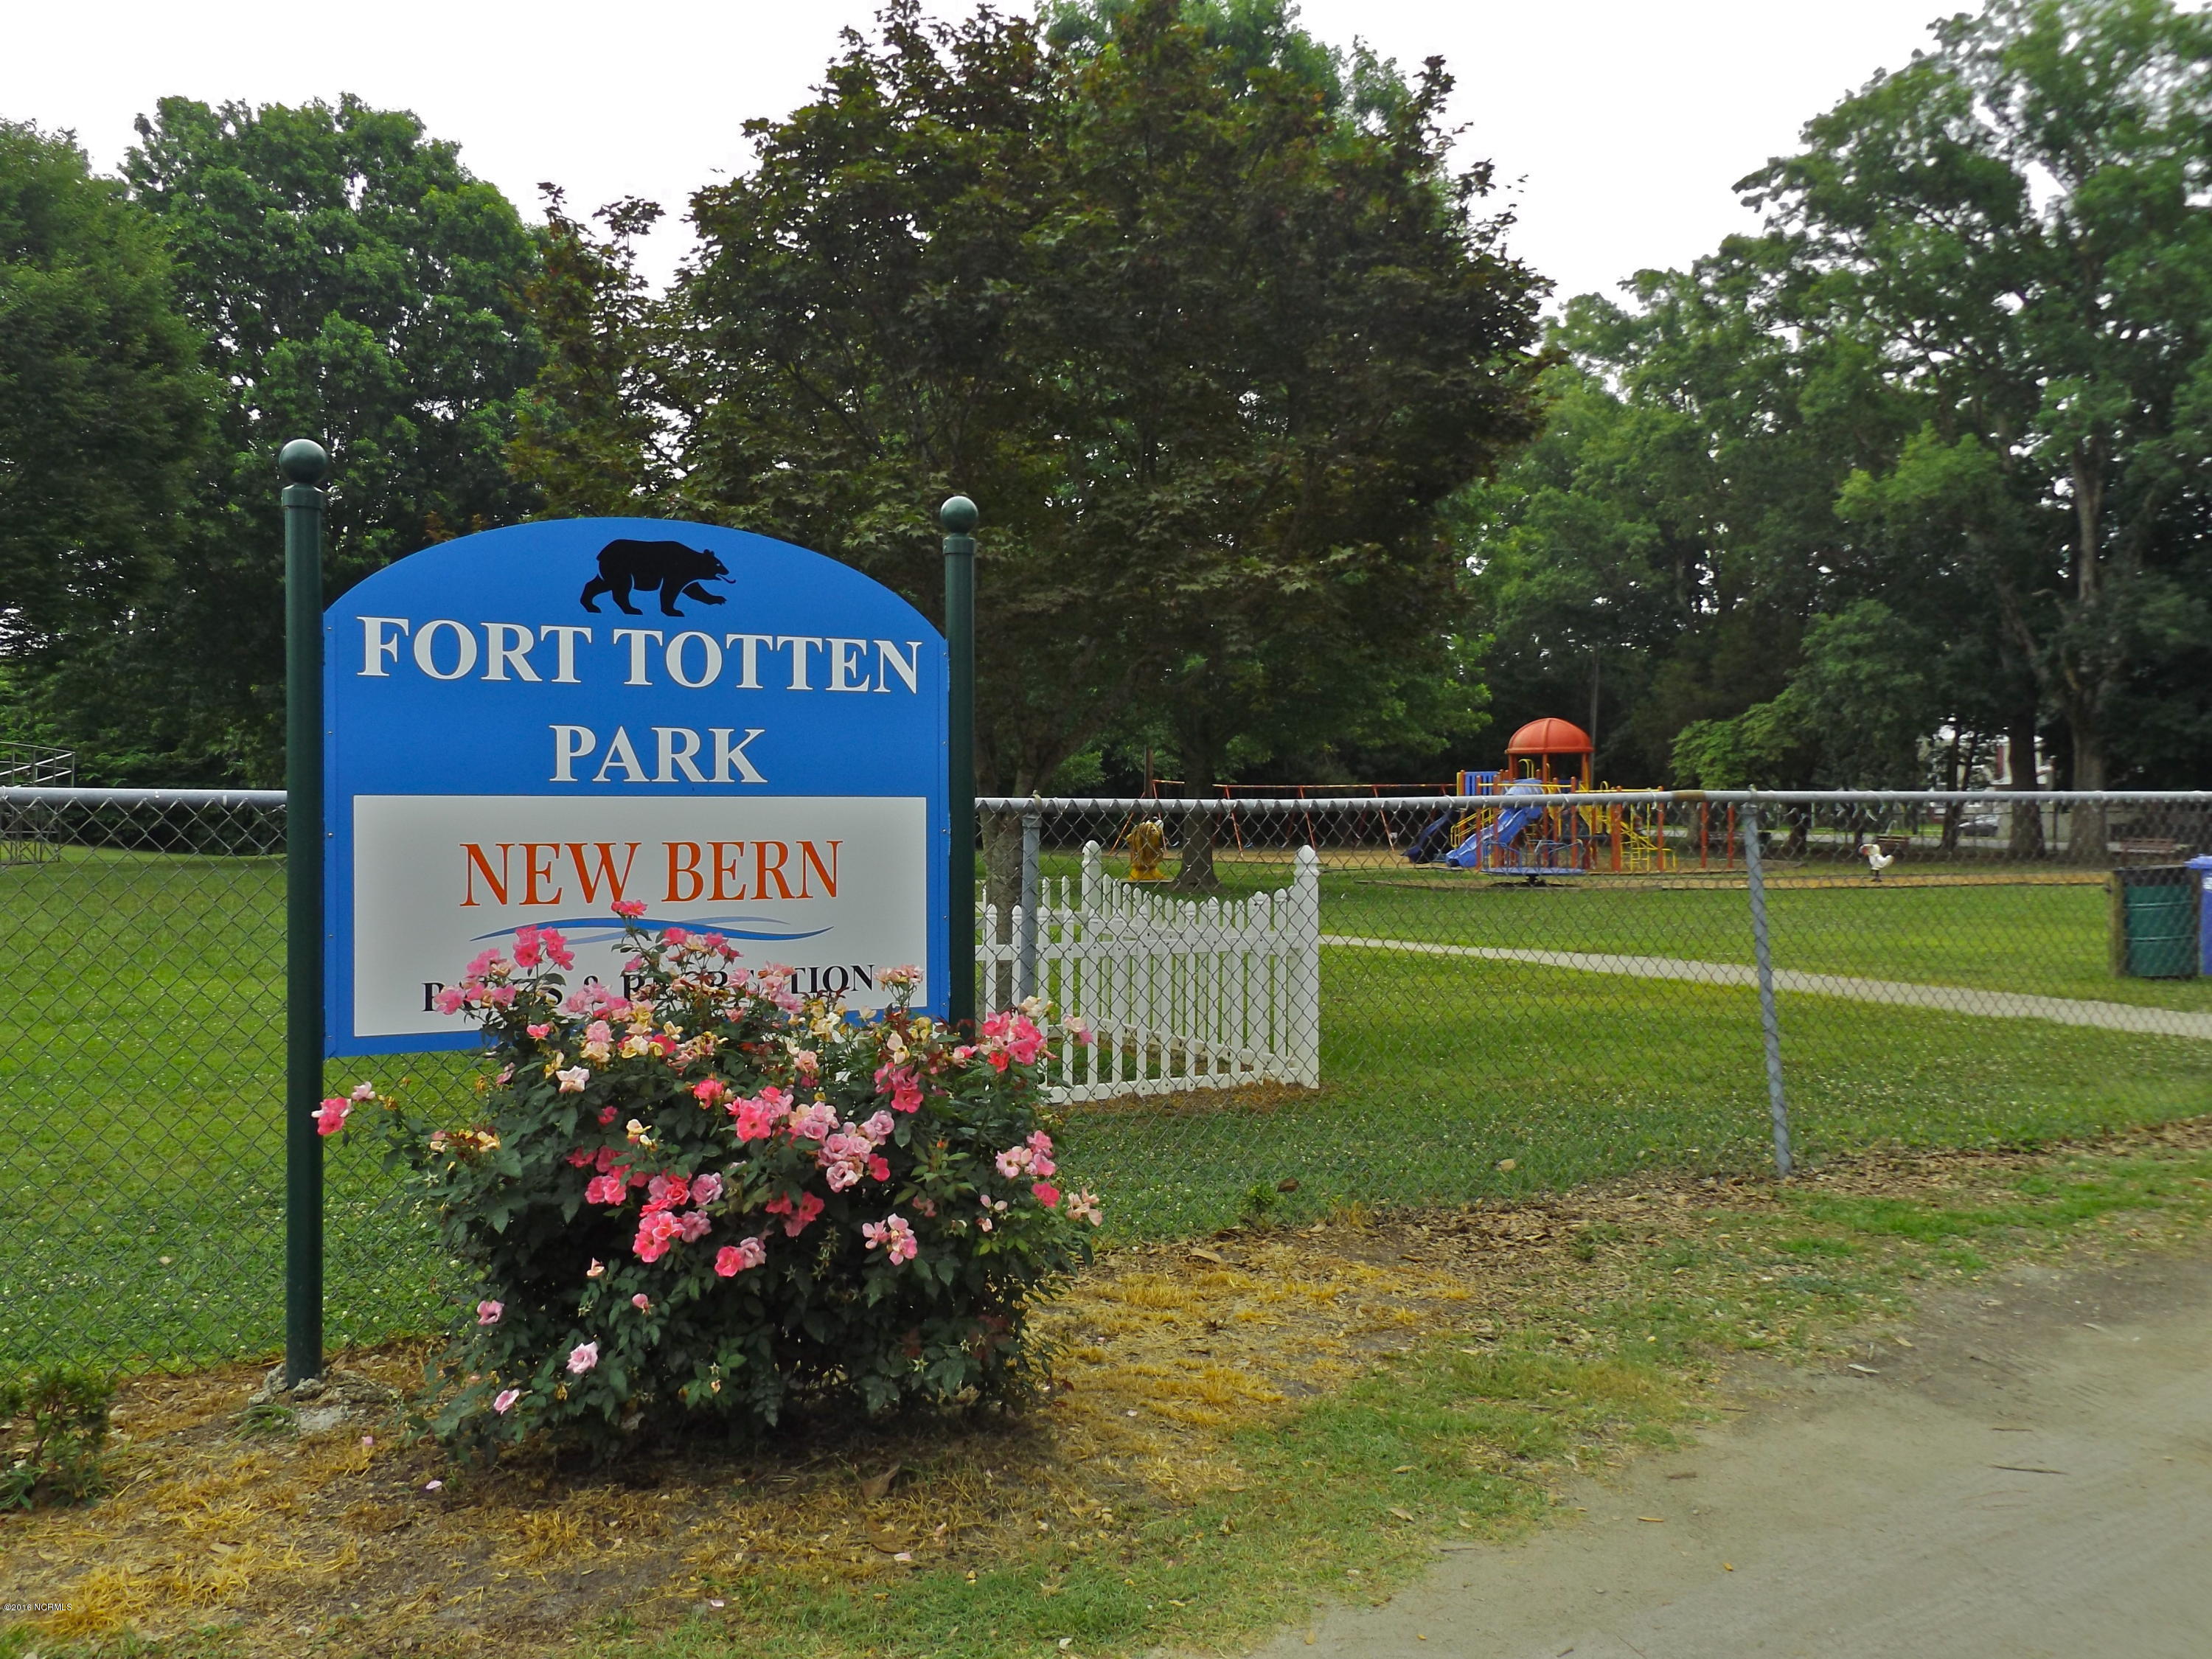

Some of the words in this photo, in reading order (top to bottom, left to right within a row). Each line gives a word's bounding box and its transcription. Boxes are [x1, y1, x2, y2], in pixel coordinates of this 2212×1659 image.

[356, 616, 593, 683] FORT
[613, 627, 923, 695] TOTTEN
[548, 724, 768, 784] PARK
[459, 842, 642, 907] NEW
[661, 840, 844, 902] BERN
[622, 964, 875, 1005] RTION
